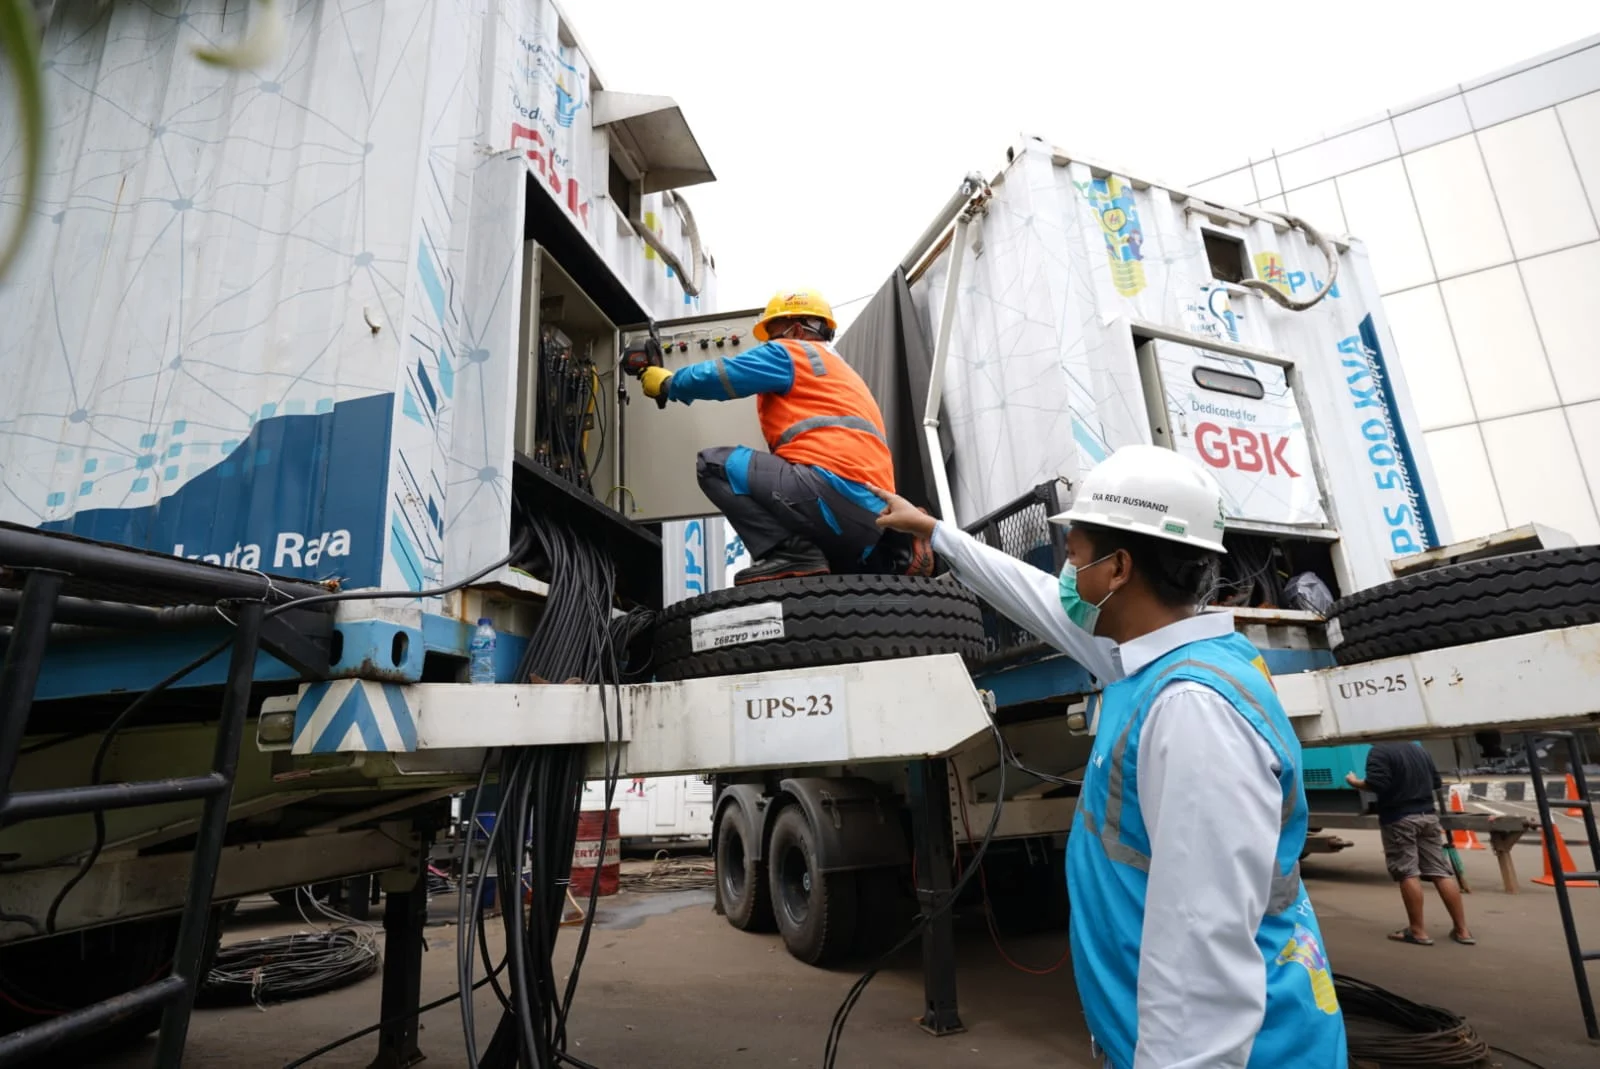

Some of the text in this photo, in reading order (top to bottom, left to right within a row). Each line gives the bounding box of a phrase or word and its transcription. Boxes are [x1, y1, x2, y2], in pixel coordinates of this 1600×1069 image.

[1337, 335, 1381, 408] KVA
[1192, 400, 1257, 423] Dedicated for
[1194, 421, 1302, 478] GBK
[1361, 418, 1405, 492] 500
[1105, 493, 1121, 504] REVI
[1122, 496, 1169, 513] RUSWANDI
[1338, 673, 1407, 700] UPS-25
[745, 694, 833, 720] UPS-23
